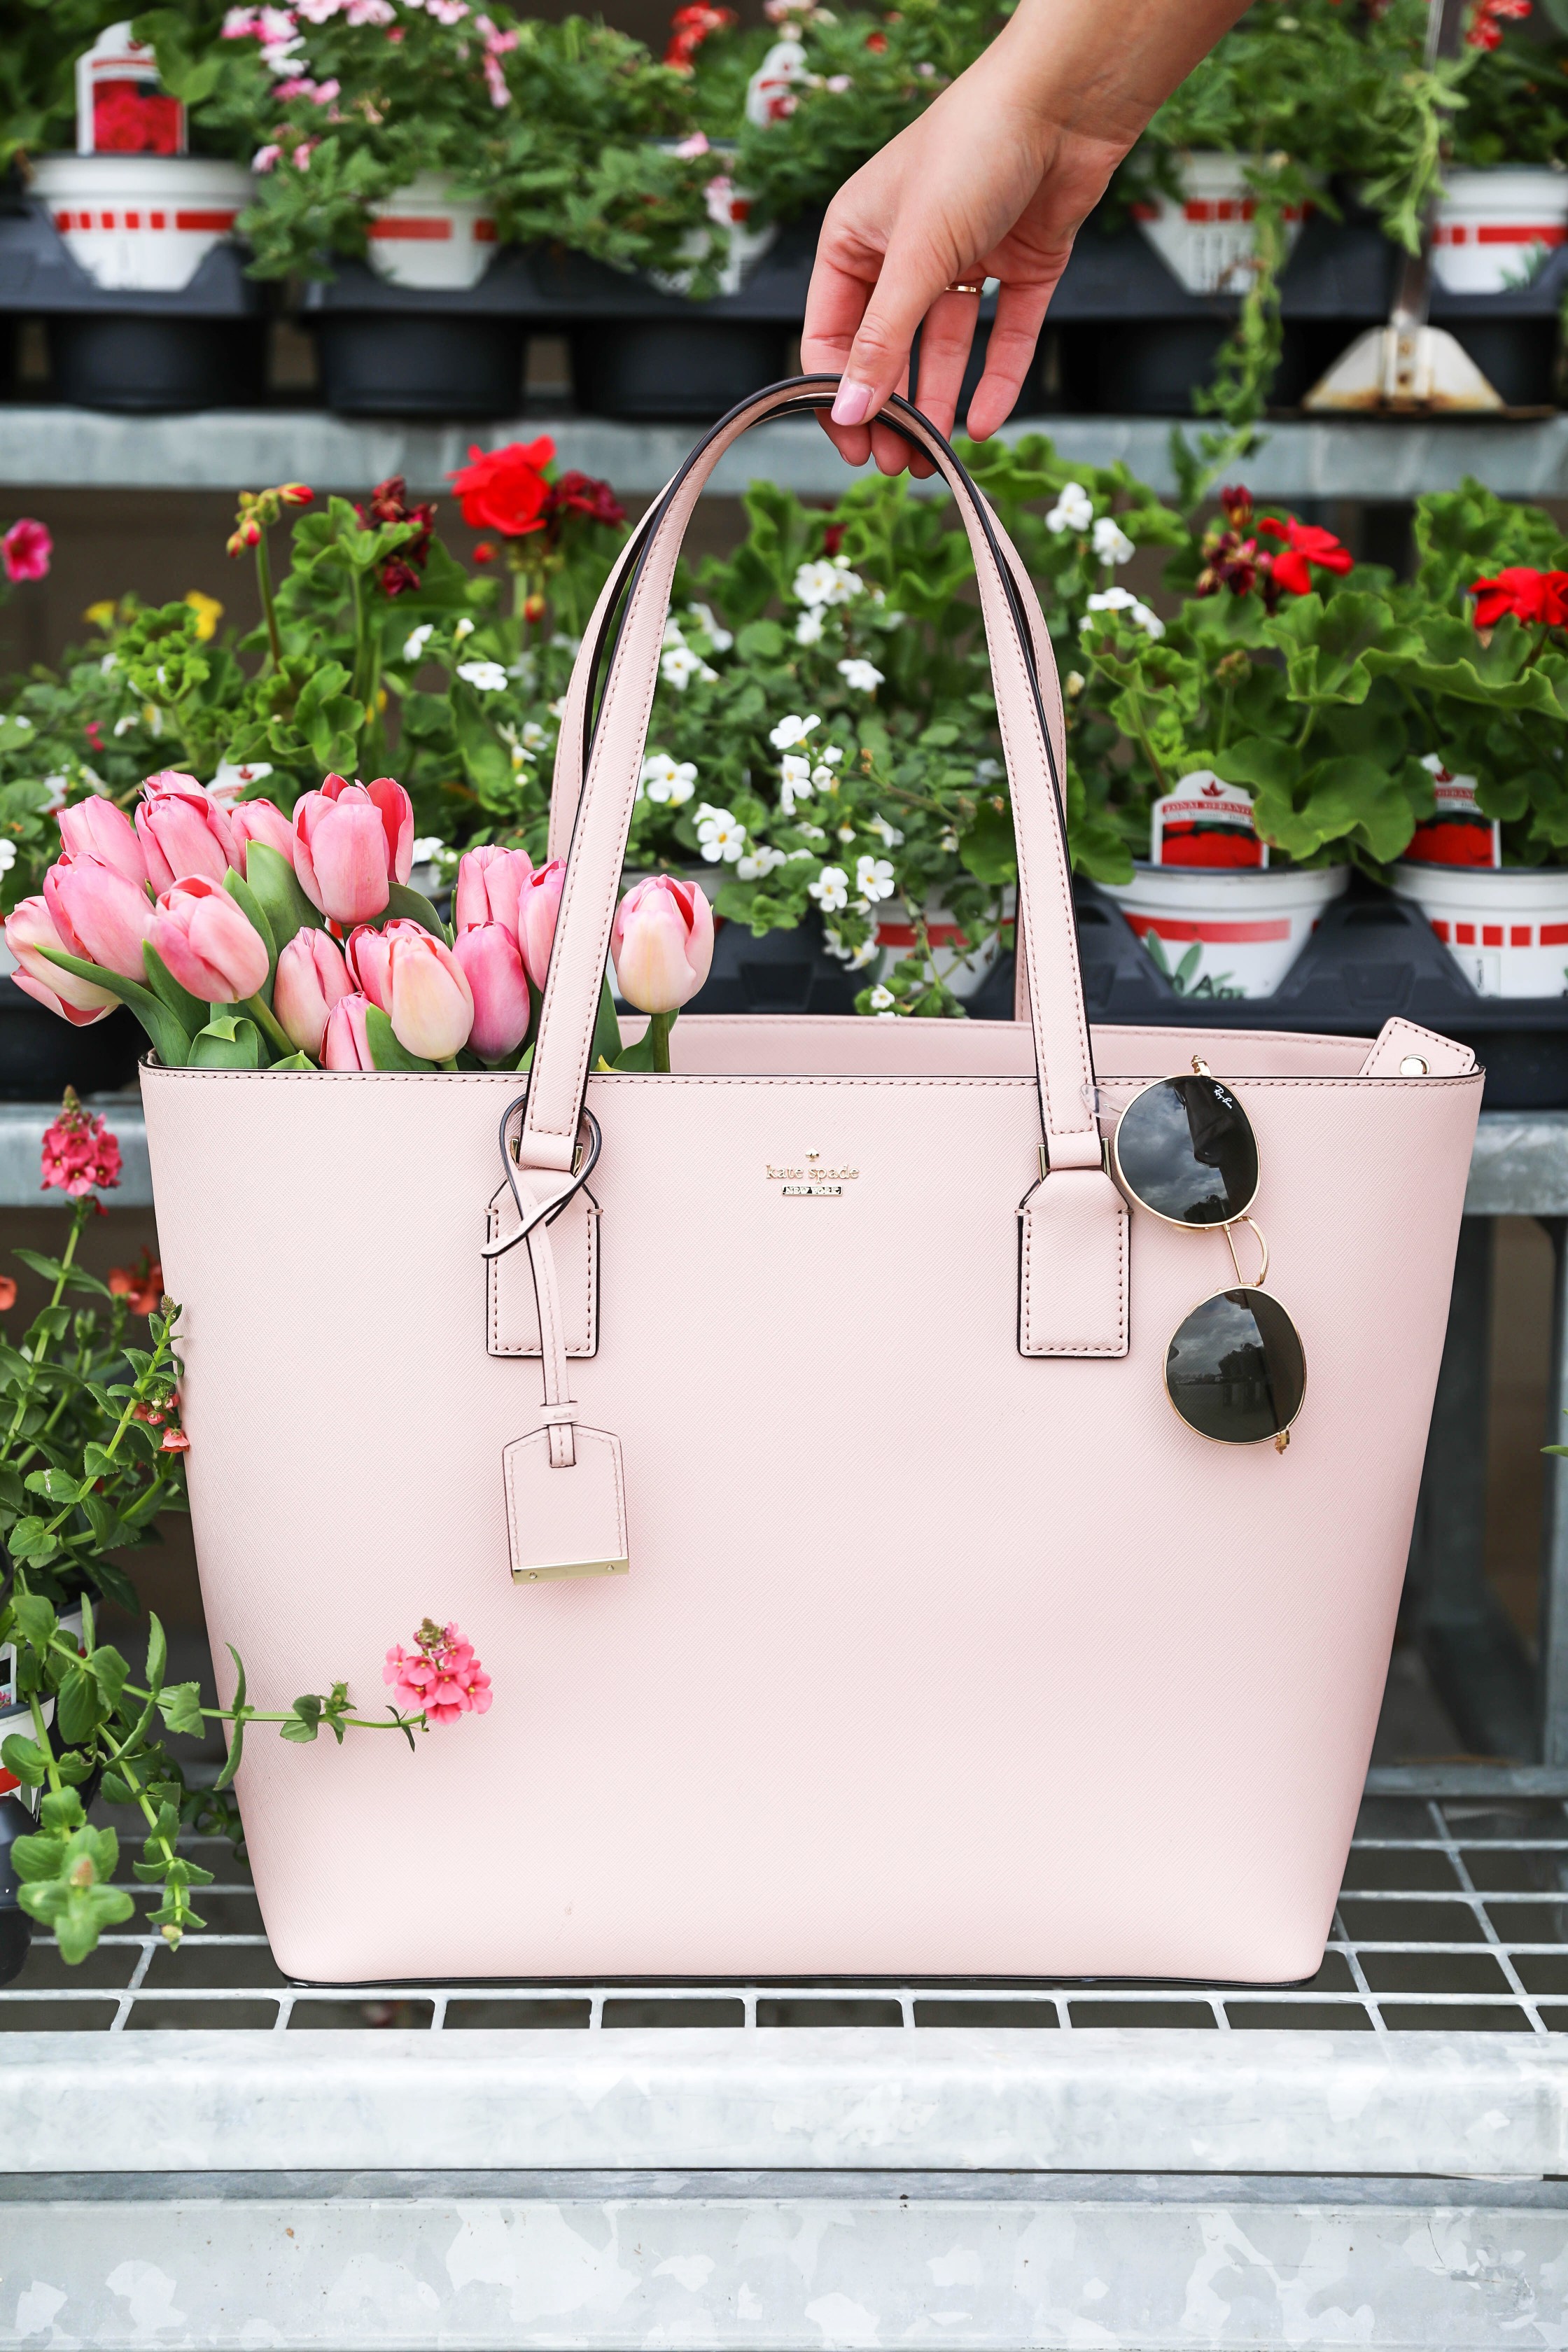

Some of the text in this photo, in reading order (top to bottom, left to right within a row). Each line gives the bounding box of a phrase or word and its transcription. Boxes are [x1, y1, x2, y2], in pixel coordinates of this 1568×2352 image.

[766, 1164, 860, 1184] kate spade
[811, 1186, 841, 1194] YORK
